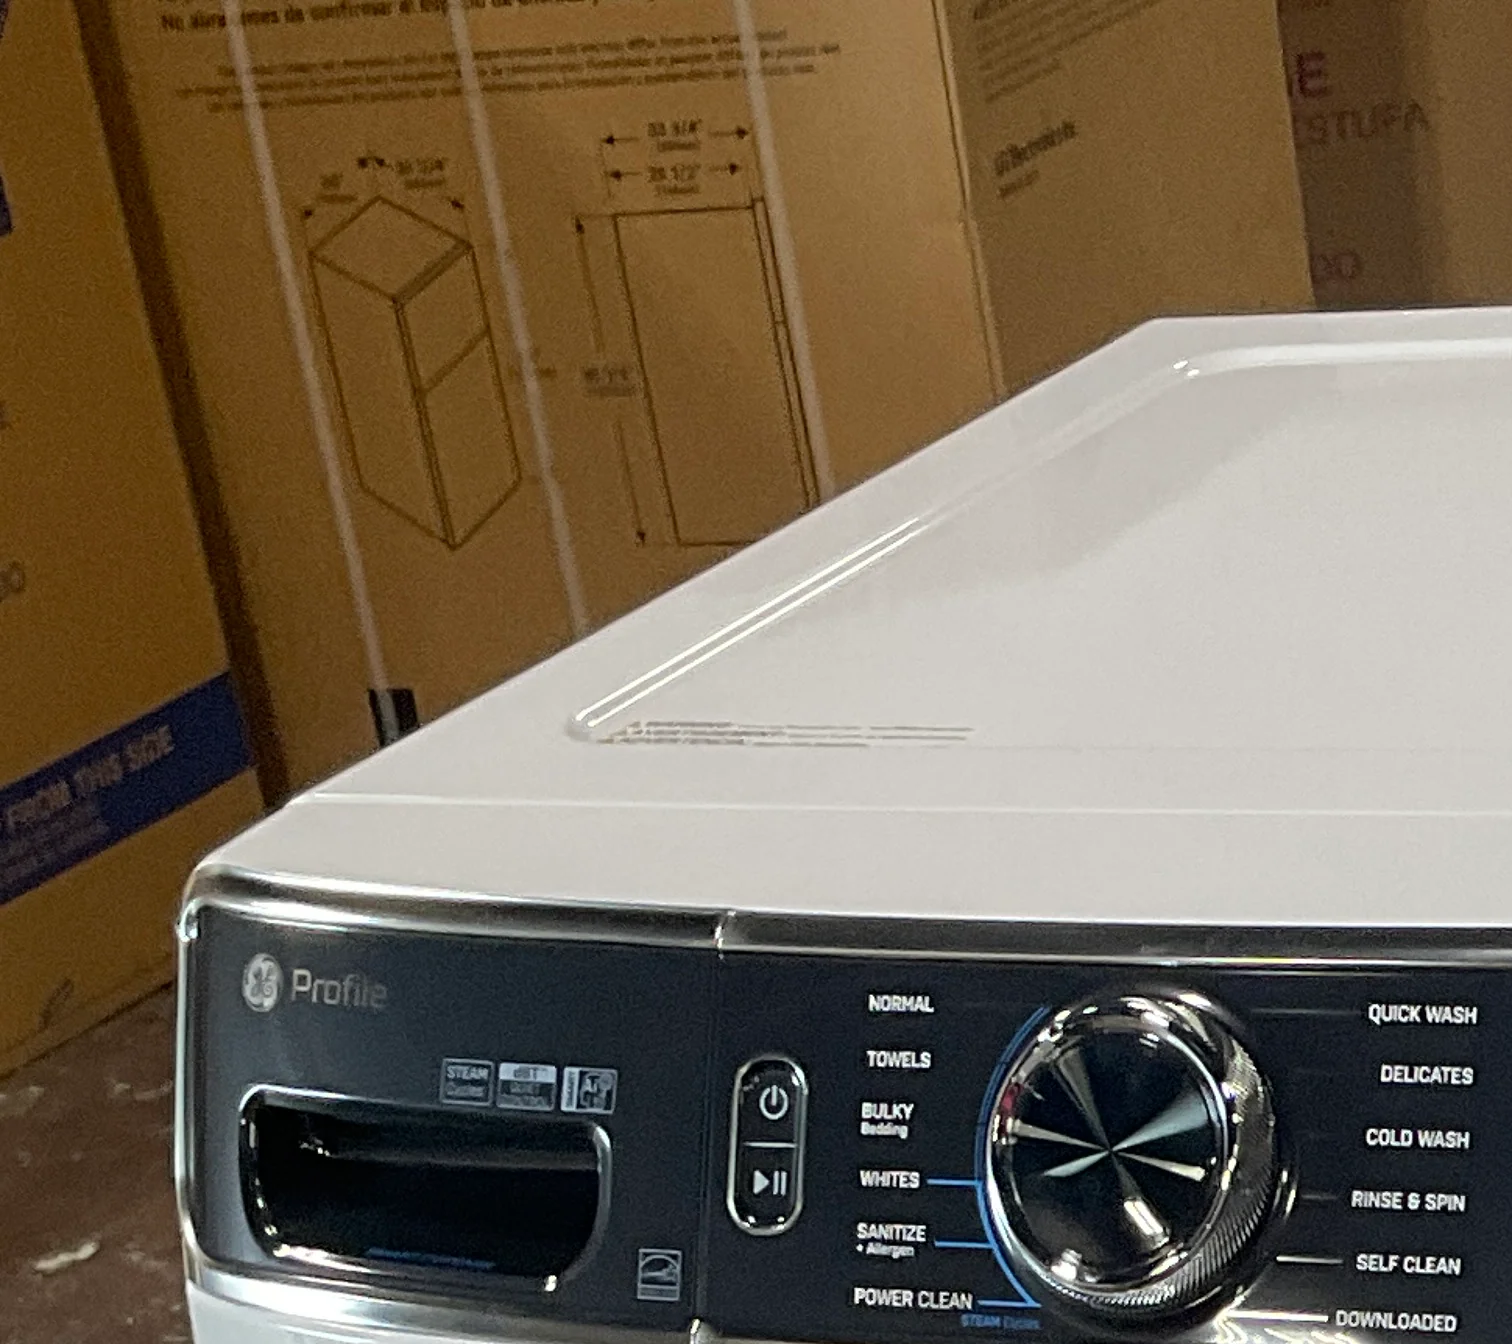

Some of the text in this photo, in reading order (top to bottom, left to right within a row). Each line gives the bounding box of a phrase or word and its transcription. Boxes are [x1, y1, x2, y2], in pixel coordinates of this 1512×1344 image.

[290, 967, 389, 1008] Profile
[868, 994, 935, 1013] NORMAL
[1367, 1003, 1479, 1026] QUICK WASH
[866, 1050, 932, 1069] TOWELS
[1380, 1064, 1475, 1086] DELICATES
[861, 1101, 915, 1120] BULKY
[860, 1122, 909, 1140] Bedding
[1365, 1127, 1471, 1150] COLD WASH
[859, 1170, 921, 1189] WHITES
[1351, 1190, 1466, 1213] RINSE & SPIN
[856, 1222, 927, 1242] SANITIZE
[1356, 1253, 1462, 1276] SELF CLEAN
[854, 1287, 974, 1310] POWER CLEAN
[1335, 1309, 1458, 1333] DOWNLOADED
